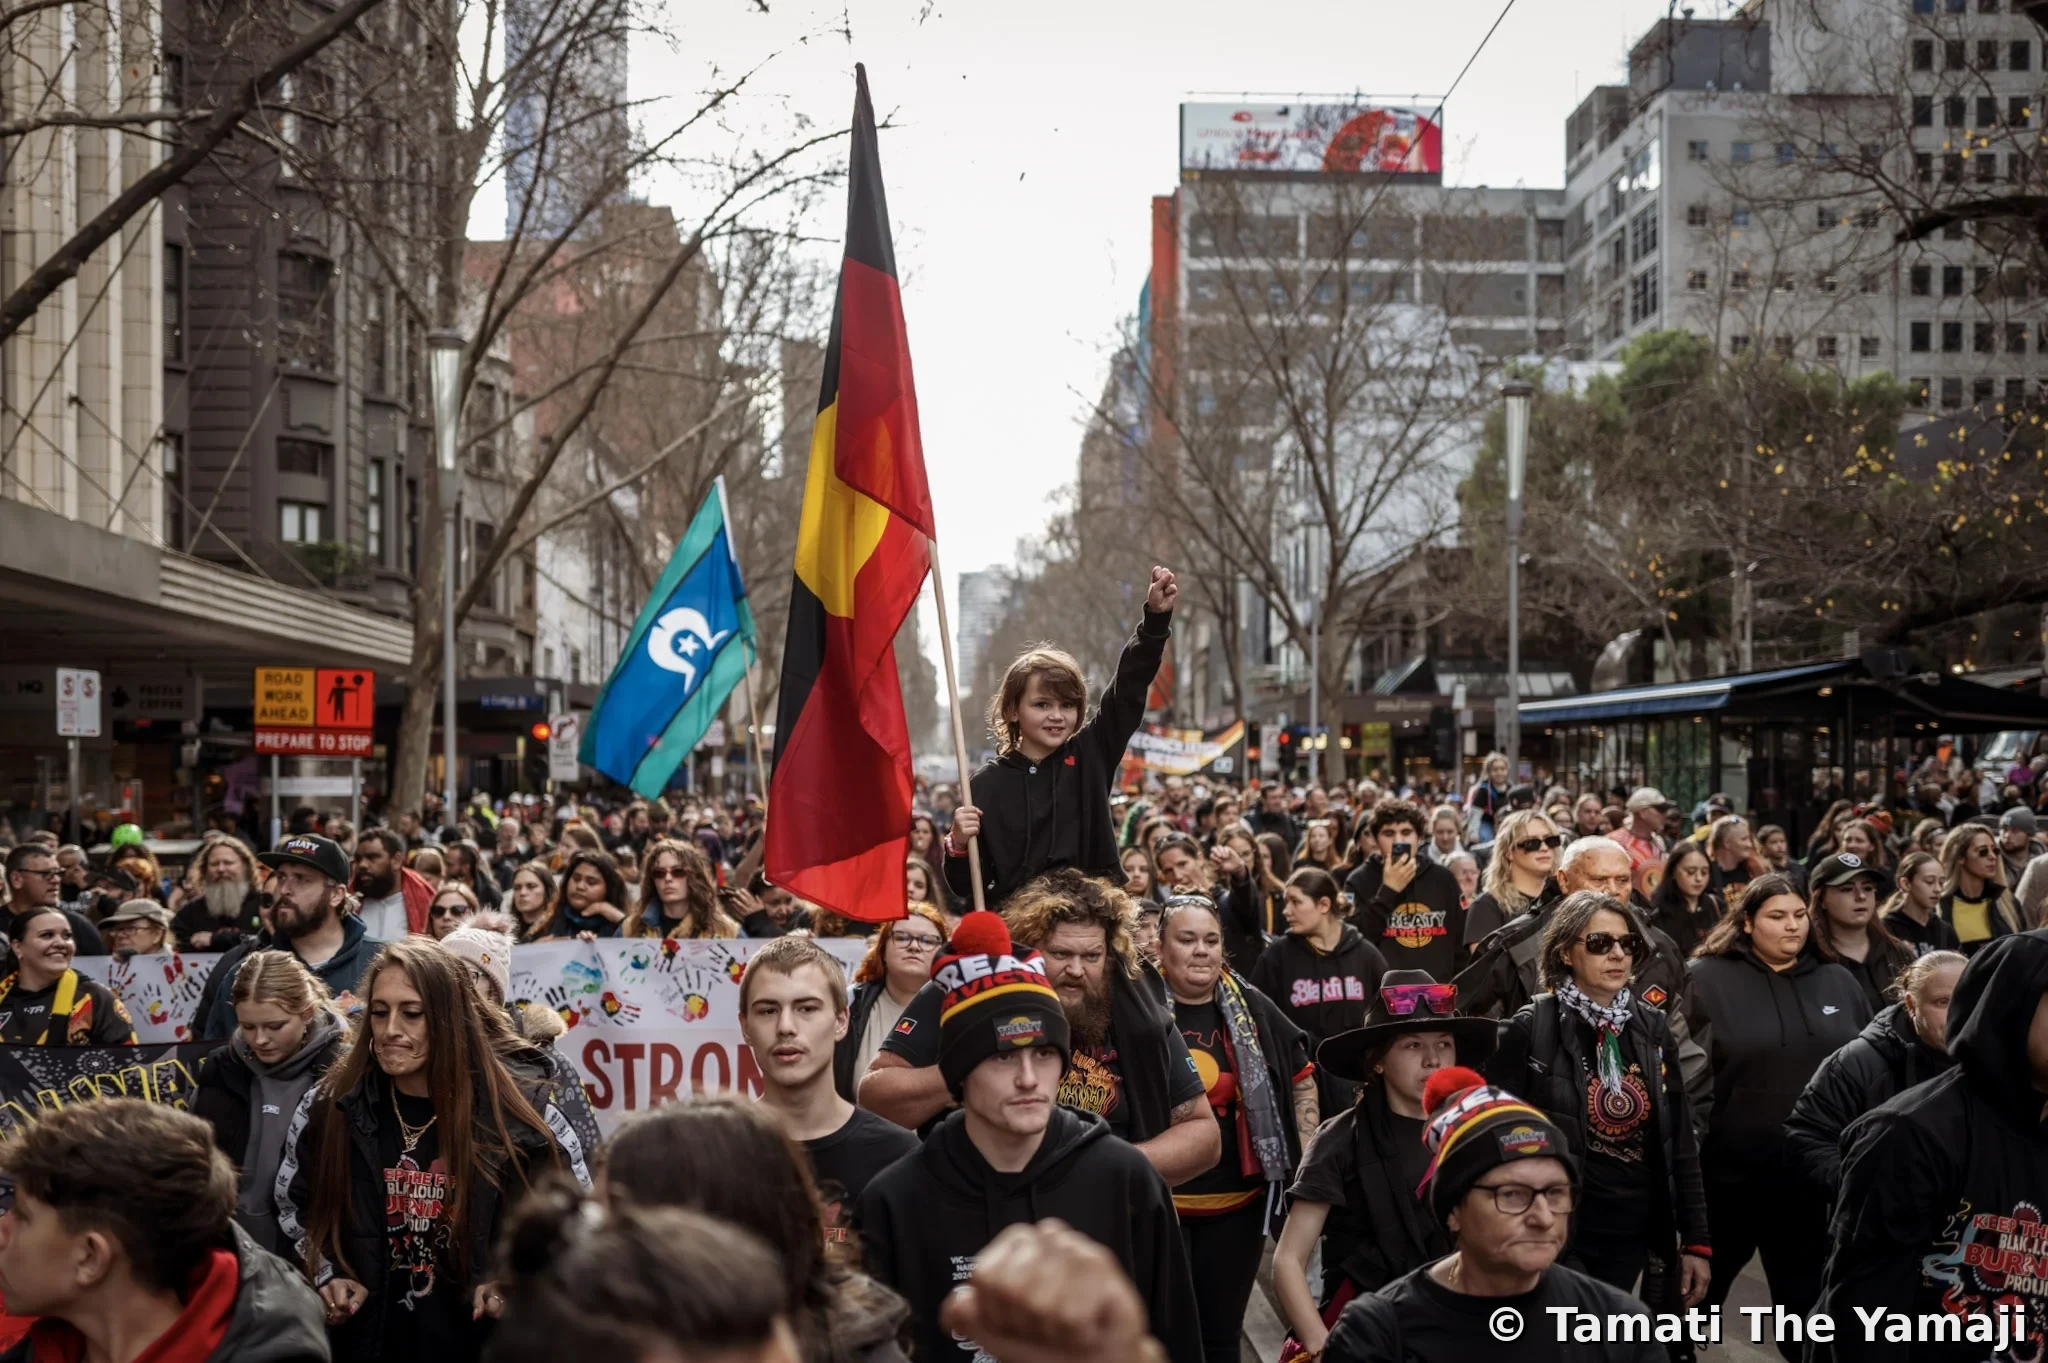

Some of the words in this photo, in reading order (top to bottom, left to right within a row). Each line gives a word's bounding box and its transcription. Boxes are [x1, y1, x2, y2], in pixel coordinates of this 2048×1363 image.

[264, 672, 303, 685] ROAD
[265, 691, 302, 703] WORK
[260, 707, 309, 720] AHEAD
[256, 732, 315, 750] PREPARE
[320, 734, 335, 750] TO
[338, 735, 371, 752] STOP
[1399, 926, 1447, 937] VICTORIA
[1972, 1214, 2018, 1234] KEEP
[2019, 1219, 2048, 1241] TH
[950, 1255, 964, 1265] VIC
[951, 1271, 973, 1281] 2024
